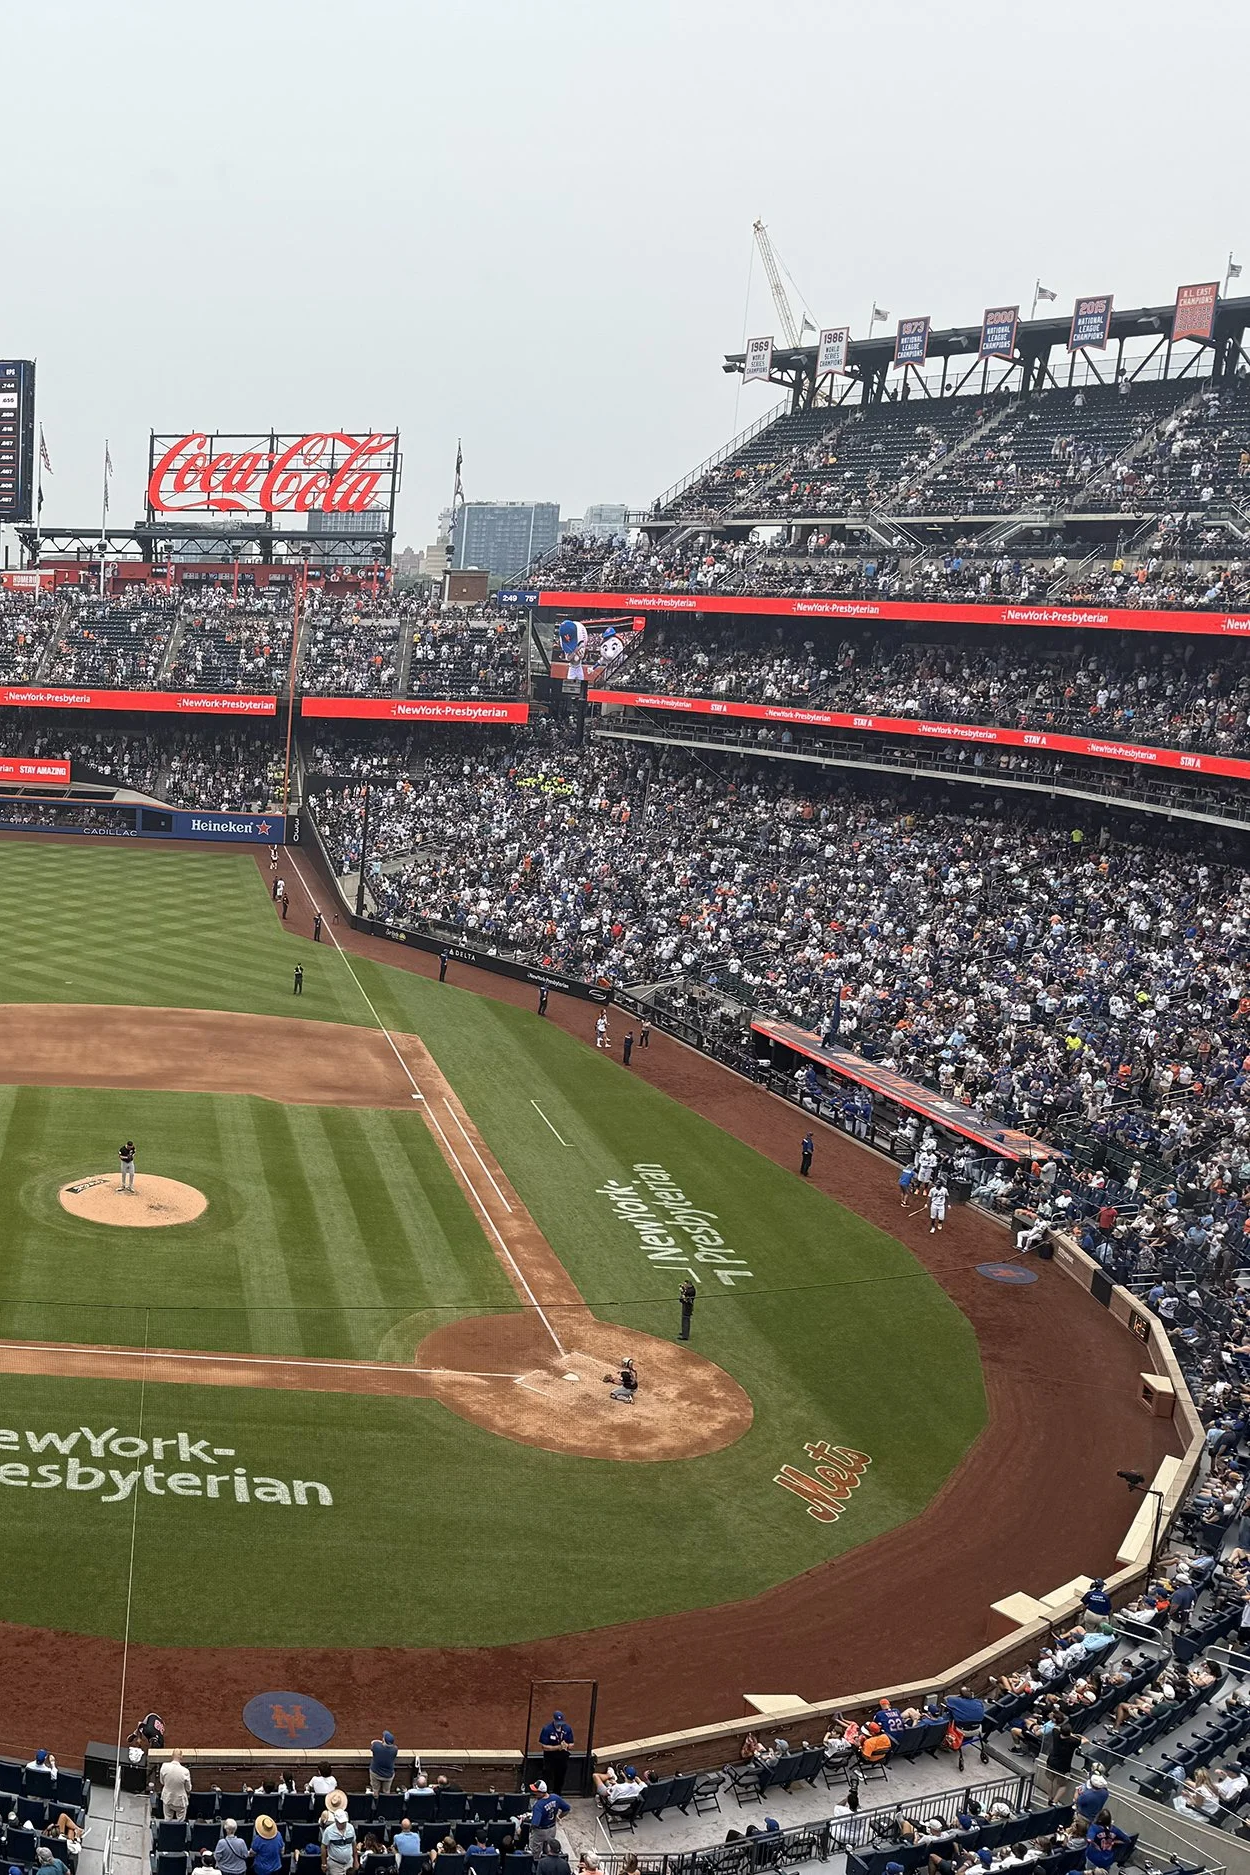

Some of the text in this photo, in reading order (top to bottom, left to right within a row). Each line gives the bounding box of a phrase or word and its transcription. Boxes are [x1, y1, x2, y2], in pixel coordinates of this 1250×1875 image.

[1078, 300, 1106, 316] 2015
[986, 311, 1015, 325] 2000
[1077, 316, 1104, 325] NATIONAL
[902, 321, 925, 335] 1973
[987, 326, 1010, 335] NATIONAL
[1078, 324, 1100, 333] LEAGUE
[824, 332, 844, 344] 1986
[901, 336, 923, 344] NATIONAL
[988, 333, 1007, 342] LEAGUE
[1073, 332, 1104, 341] CHAMPIONS
[751, 341, 769, 352] 1969
[902, 343, 920, 351] LEAGUE
[983, 341, 1010, 350] CHAMPIONS
[897, 350, 923, 359] CHAMPIONS
[819, 359, 843, 367] CHAMPIONS
[149, 432, 400, 512] Coca-Cola
[628, 597, 697, 608] NewYork-Presbyterian
[795, 601, 879, 615] NewYork-Presbyterian
[1006, 610, 1109, 625] NewYork-Presbyterian
[181, 697, 275, 711] NewYork-Presbyterian
[397, 704, 508, 717] NewYork-Presbyterian
[638, 697, 692, 708] NewYork-Presbyterian
[710, 703, 722, 712] STAY
[768, 708, 832, 722] NewYork-Presbyterian
[853, 717, 867, 727] STAY
[922, 723, 997, 740] NewYork-Presbyterian
[1023, 734, 1041, 744] STAY
[1090, 742, 1157, 760] NewYork-Presbyterian
[1180, 756, 1195, 766] STAY
[19, 765, 35, 775] STAY
[36, 766, 67, 776] AMAZING
[83, 827, 138, 837] CADILLAC
[191, 818, 253, 833] Heineken
[455, 950, 477, 961] DELTA
[595, 1179, 690, 1261] NewYork-
[632, 1163, 748, 1264] Presbyterian
[772, 1440, 872, 1523] Mets
[887, 1718, 903, 1732] 22
